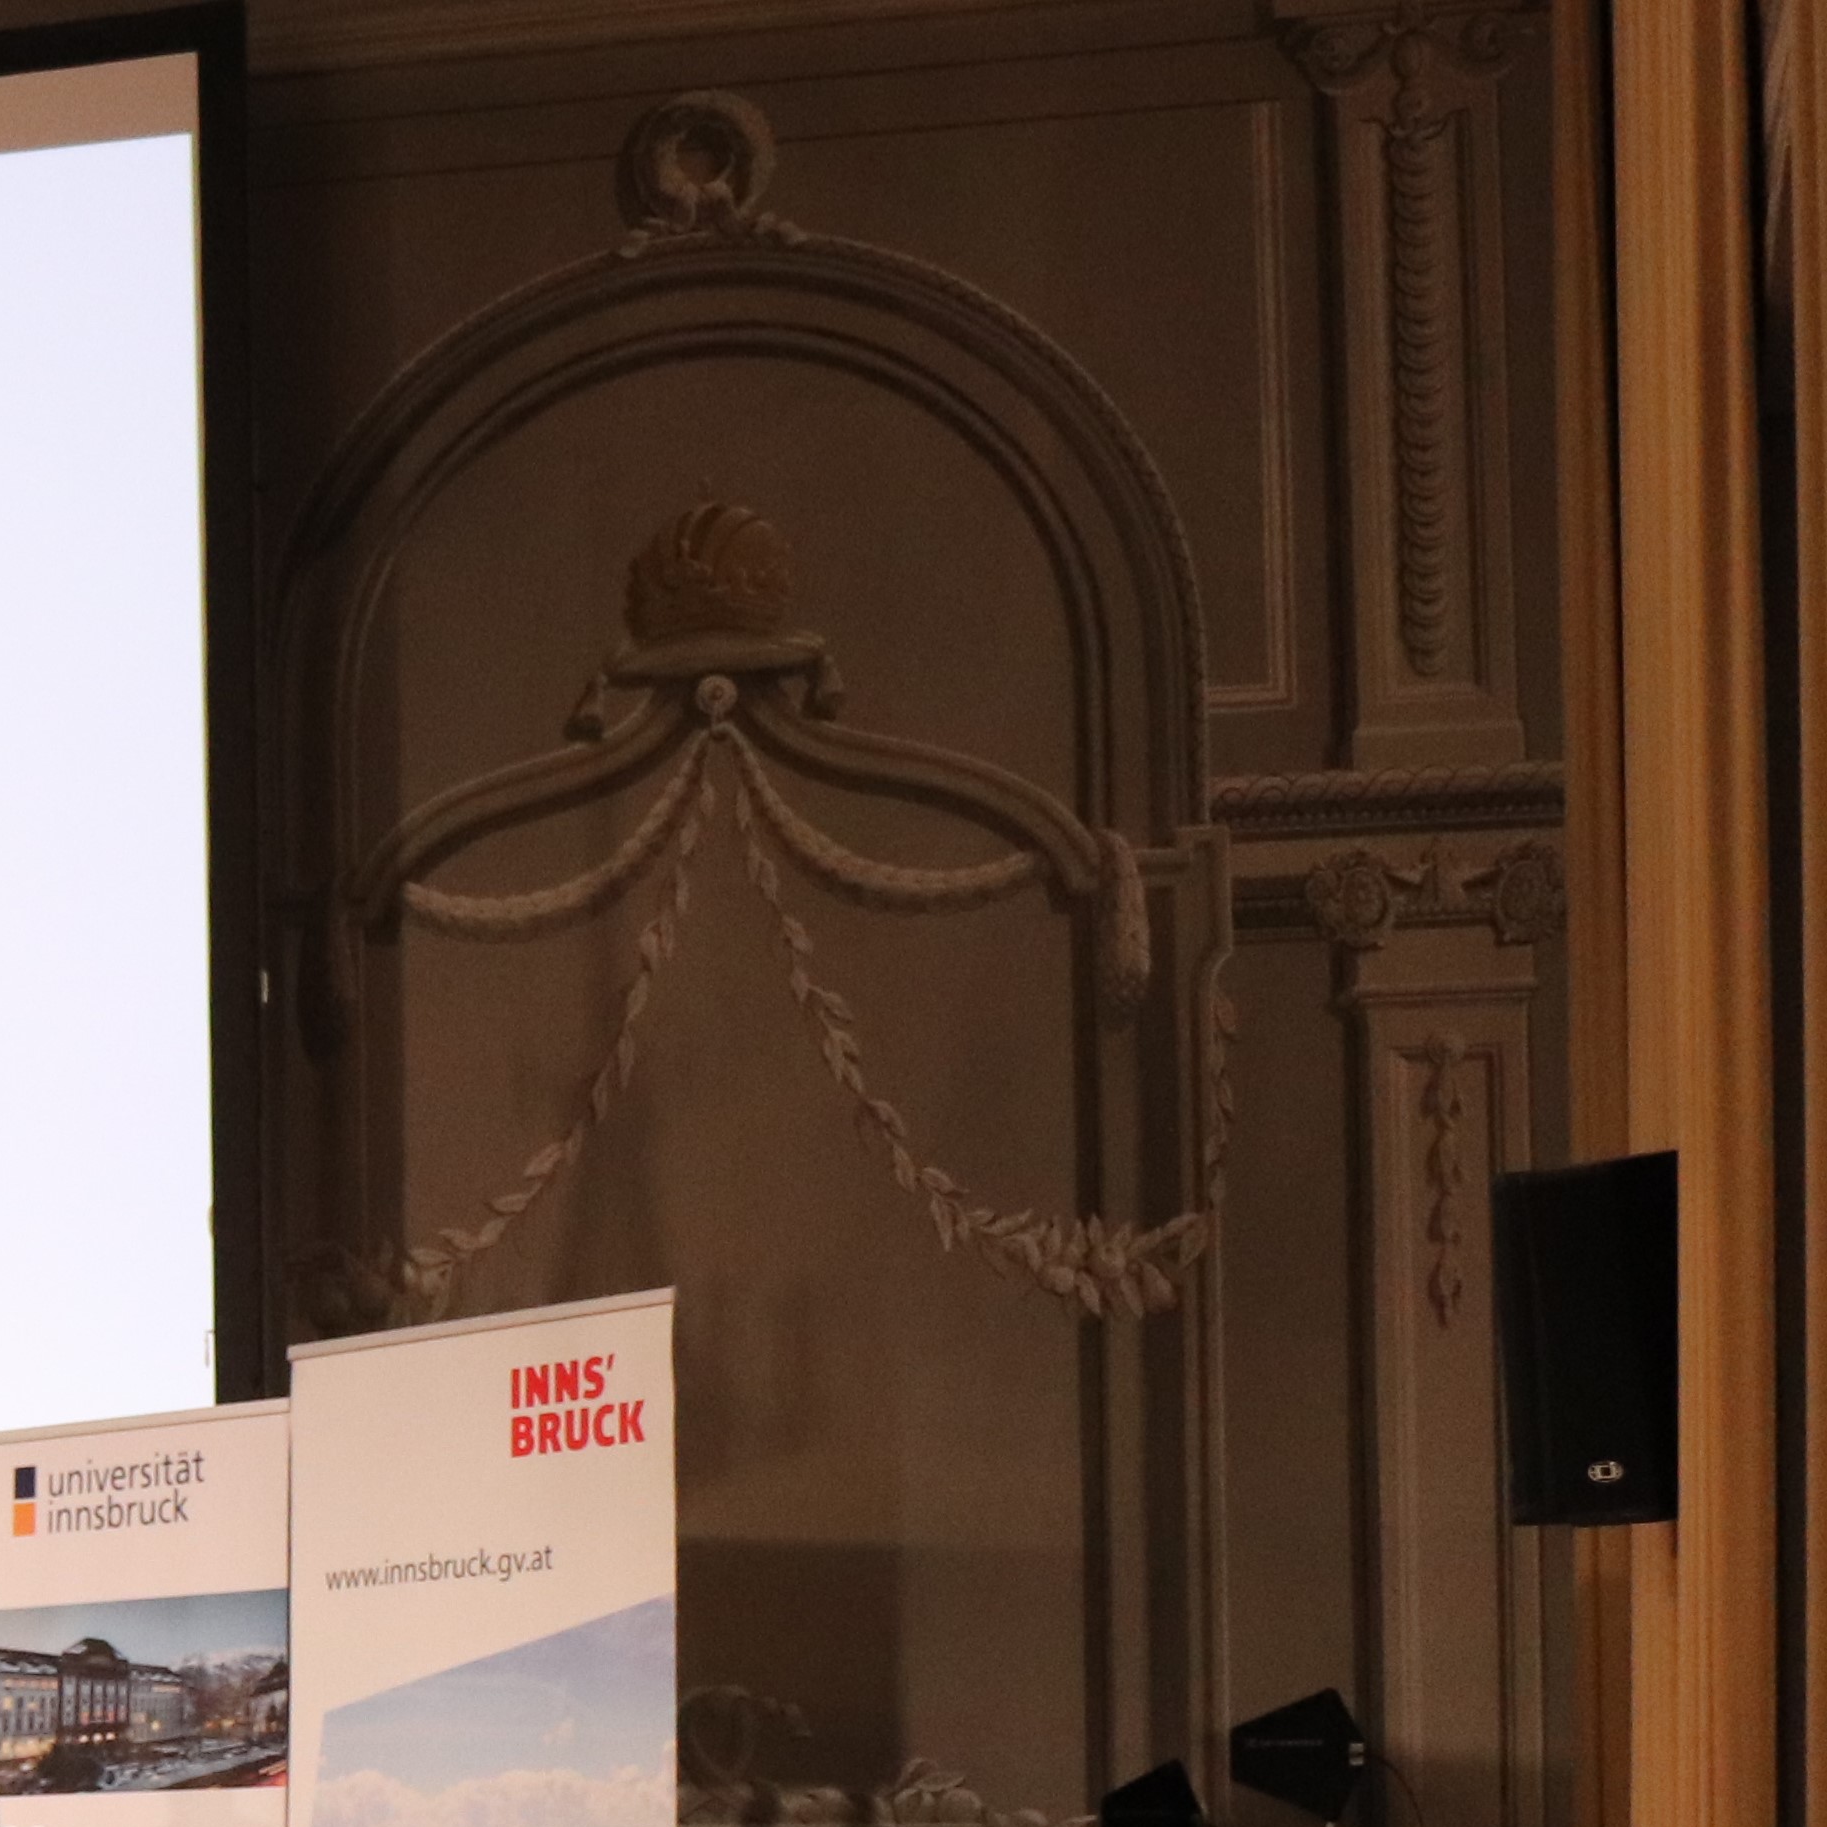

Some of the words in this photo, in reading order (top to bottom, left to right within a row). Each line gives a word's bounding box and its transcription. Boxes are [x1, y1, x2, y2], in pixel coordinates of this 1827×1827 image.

[510, 1400, 645, 1458] BRUCK
[48, 1450, 205, 1497] universität
[47, 1488, 189, 1533] innsbruck
[325, 1545, 553, 1590] www.innsbruck.gv.at
